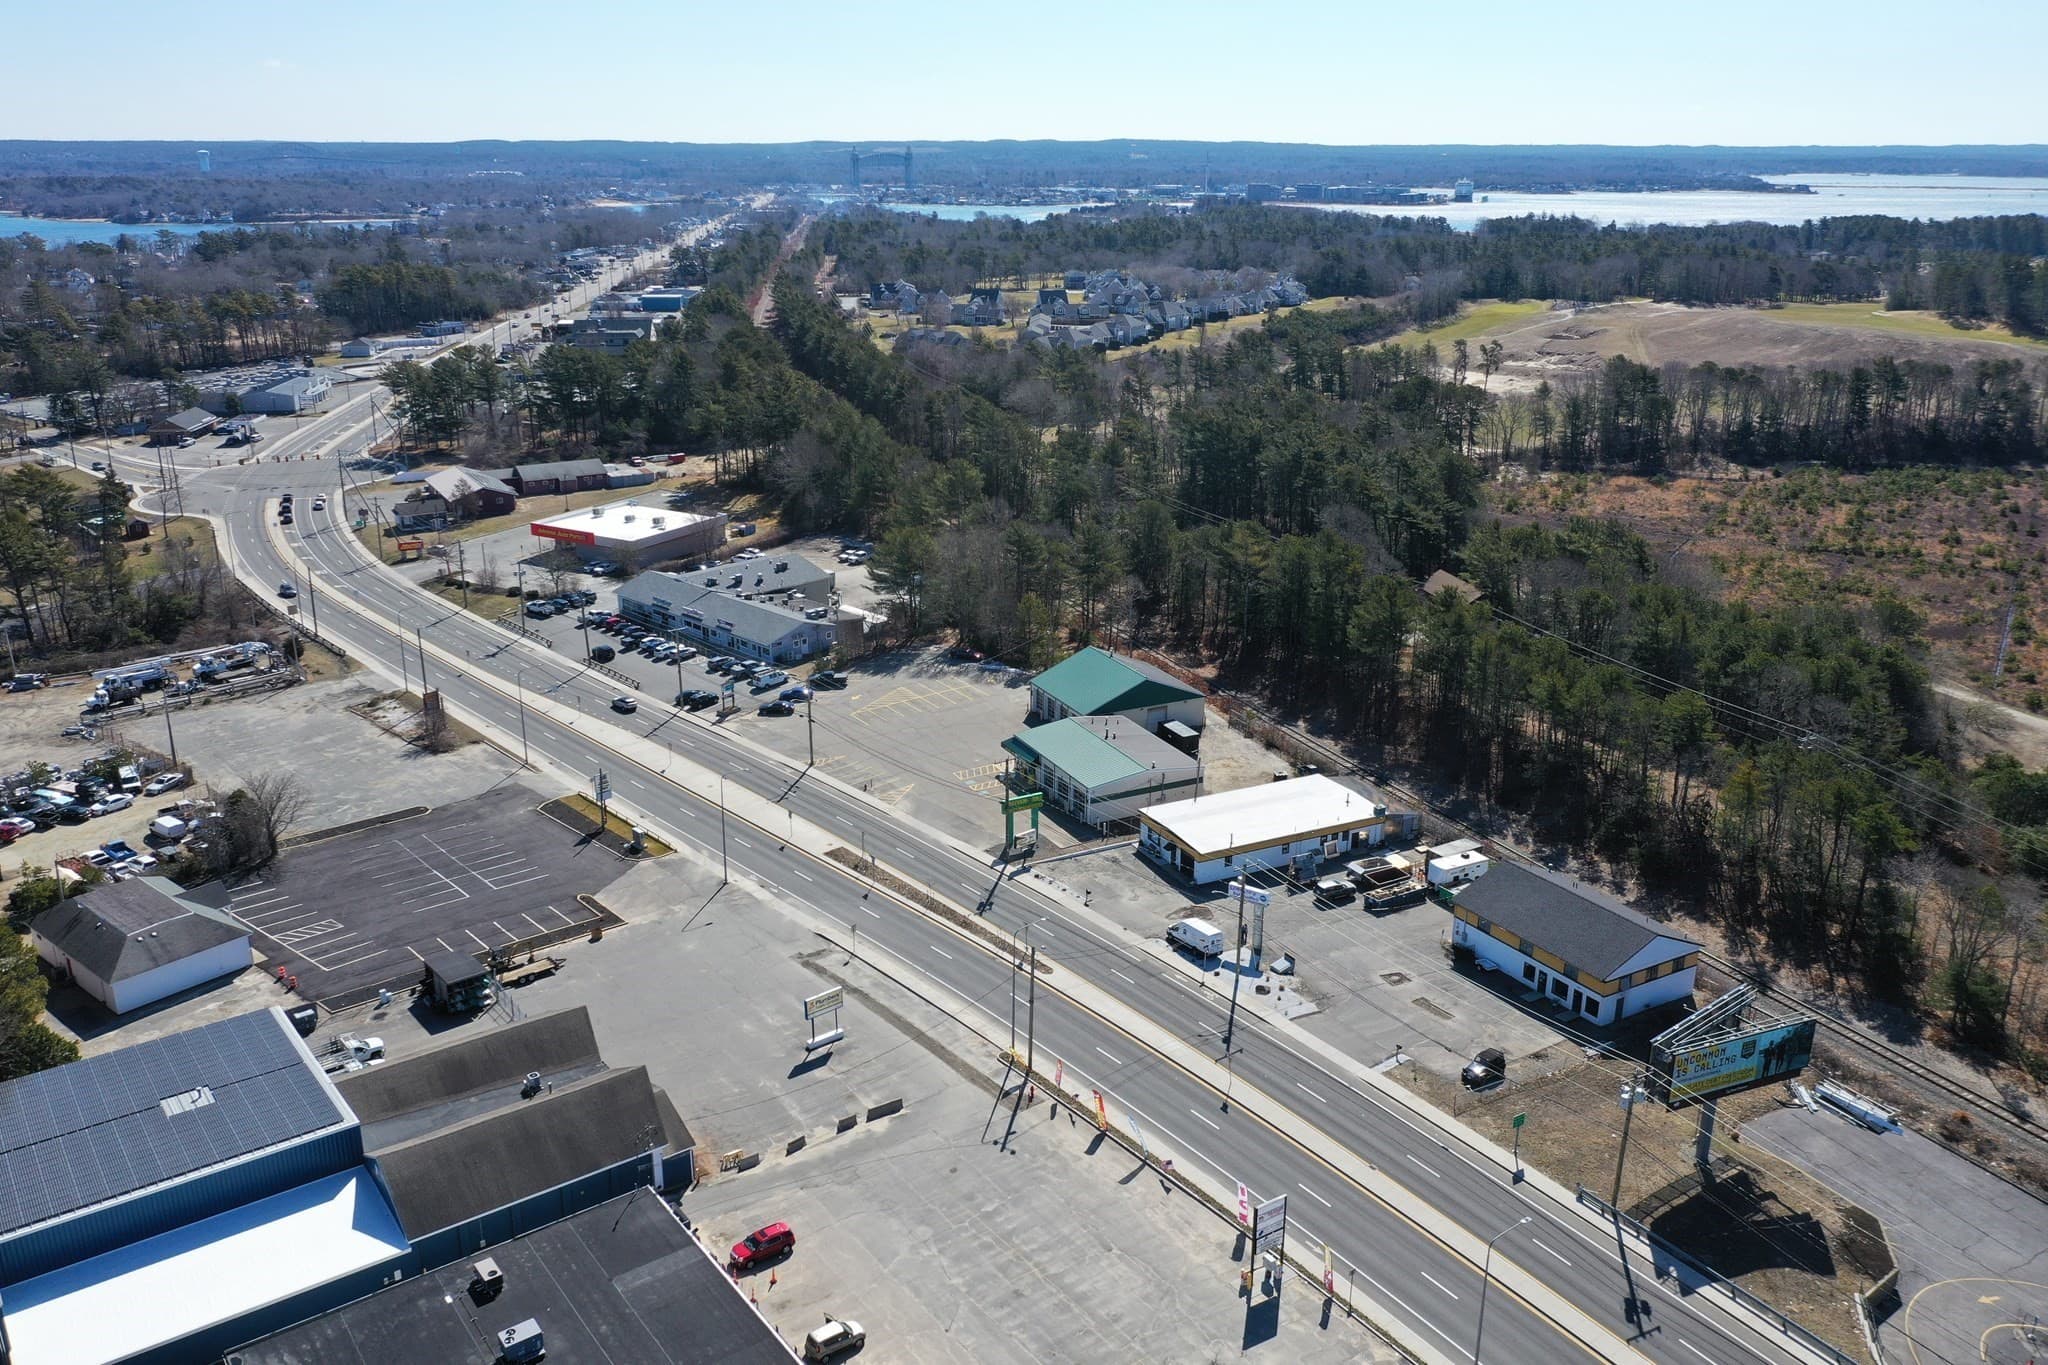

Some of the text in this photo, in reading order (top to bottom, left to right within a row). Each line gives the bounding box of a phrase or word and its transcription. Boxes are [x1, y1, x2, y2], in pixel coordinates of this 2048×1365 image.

[1677, 1047, 1727, 1068] UNCOMMON
[1677, 1068, 1688, 1077] IS
[1694, 1055, 1737, 1073] CALLING
